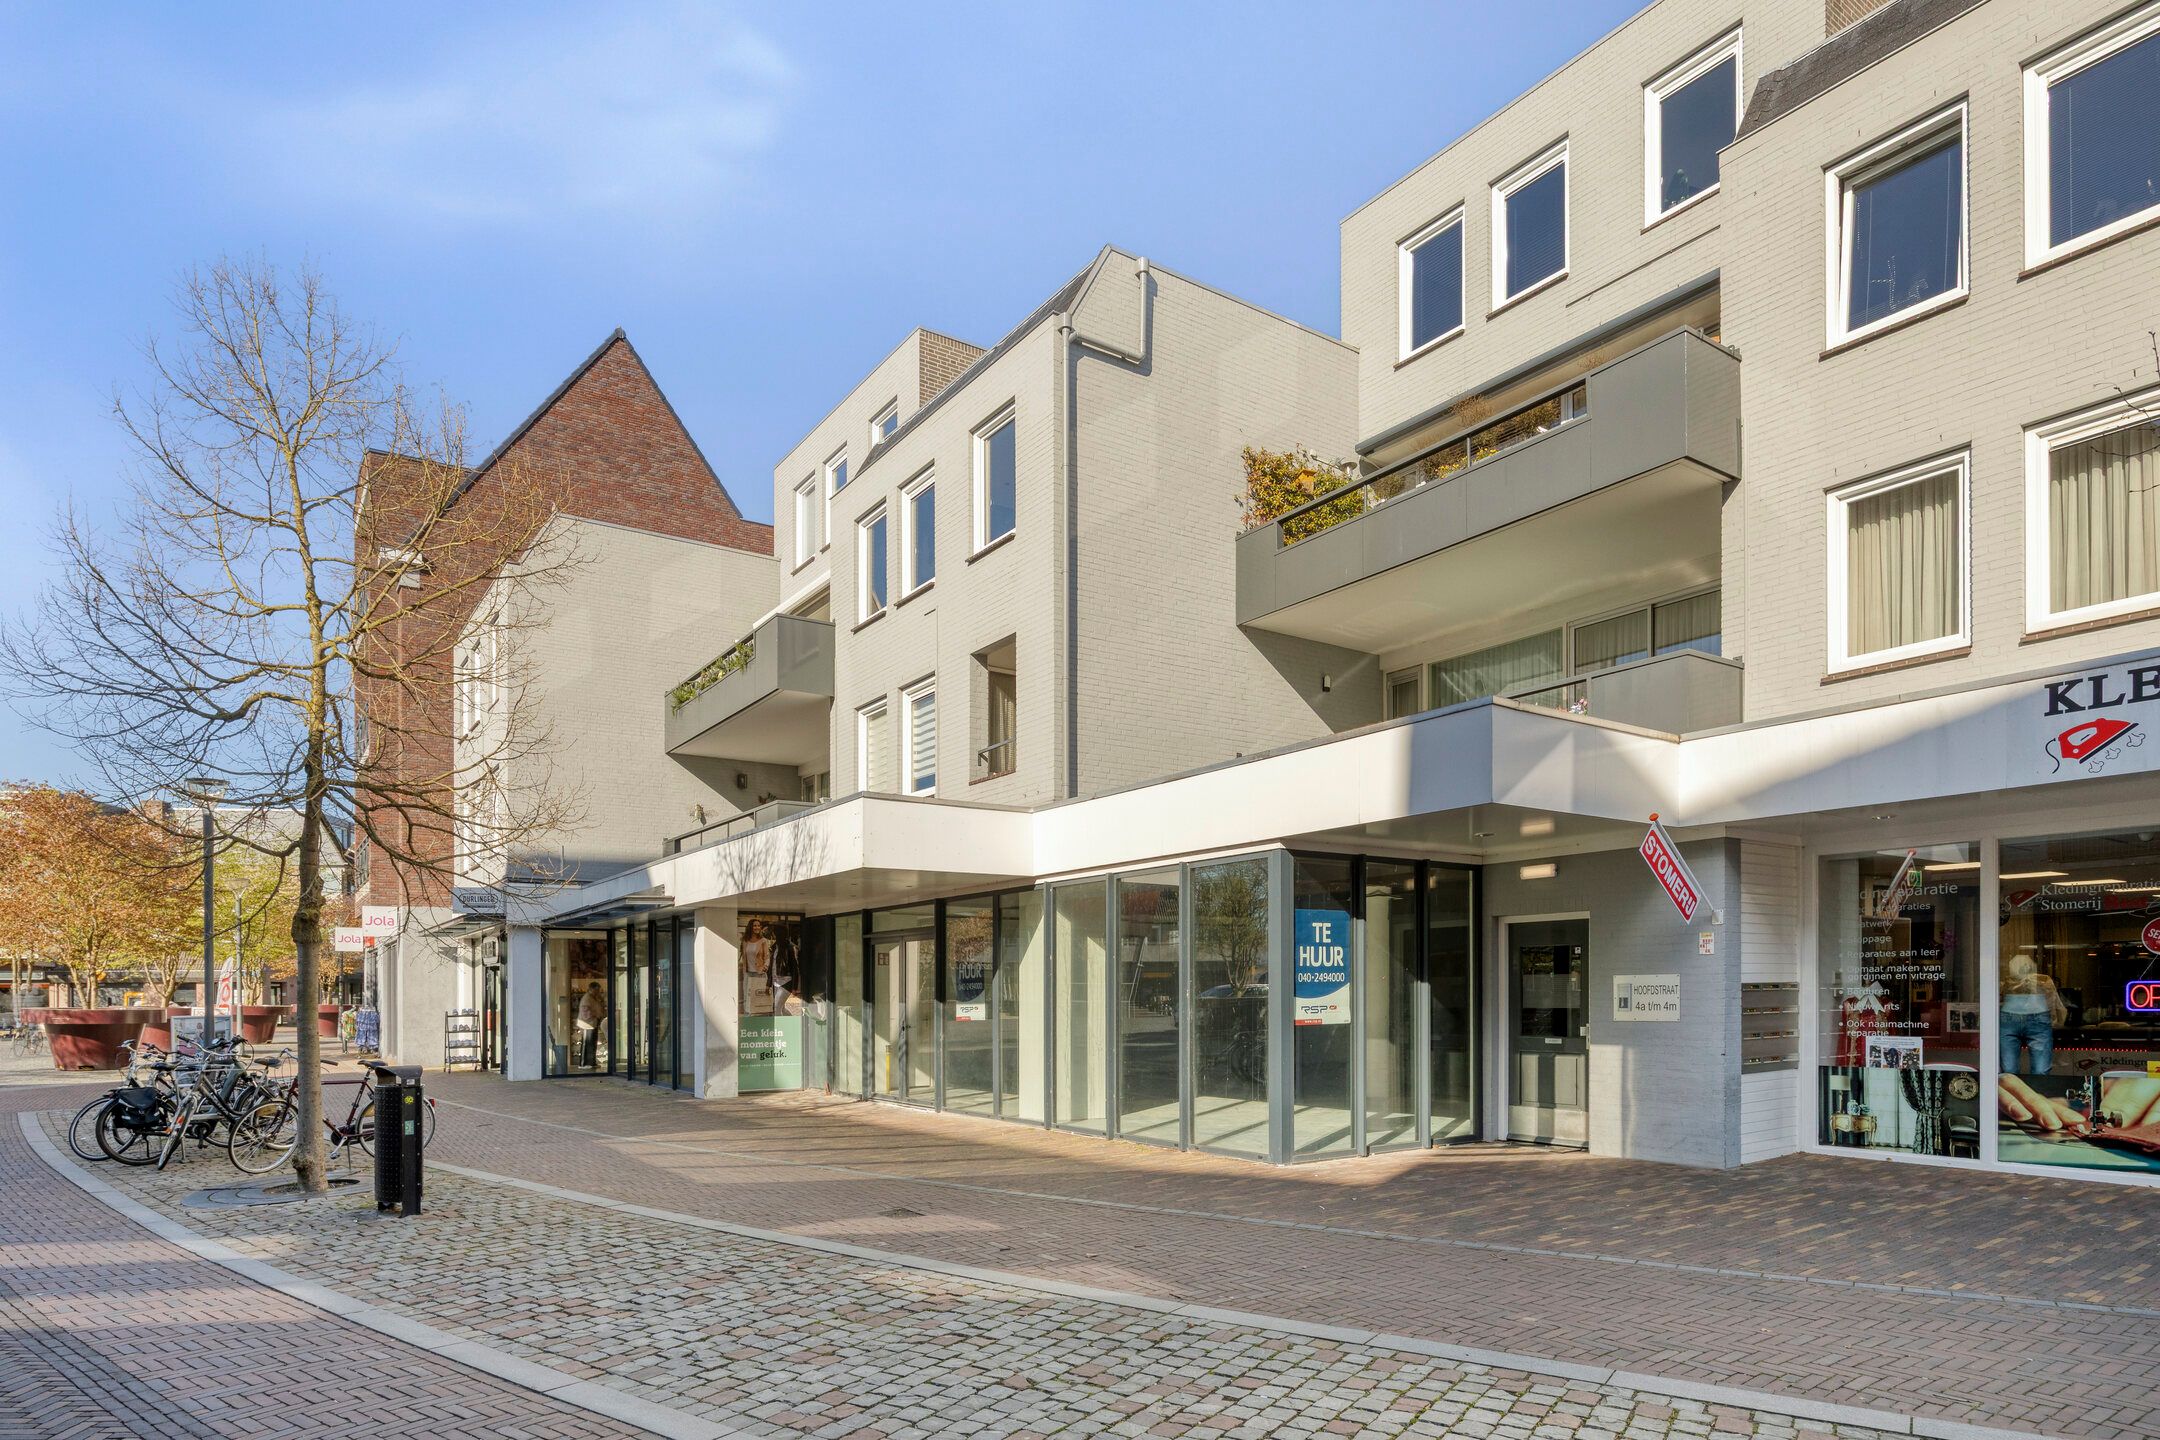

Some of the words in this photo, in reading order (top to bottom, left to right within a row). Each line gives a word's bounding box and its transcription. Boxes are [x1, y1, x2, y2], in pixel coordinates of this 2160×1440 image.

[1645, 835, 1696, 916] STOMERIJ
[2041, 896, 2101, 911] Stomerij
[365, 915, 395, 927] Jola
[1311, 922, 1332, 943] TE
[337, 934, 361, 944] Jola
[1299, 945, 1344, 967] HUUR
[1847, 949, 1897, 960] Reparaties
[1920, 948, 1940, 957] leer
[958, 961, 982, 979] HUUR
[1887, 964, 1920, 973] maken
[1895, 973, 1908, 981] en
[1910, 971, 1946, 981] vitrage
[1633, 984, 1679, 995] HOOFDSTRAAT
[1635, 1001, 1646, 1011] 4a
[1648, 1001, 1661, 1011] t/m
[1663, 1001, 1677, 1011] 4m
[1884, 1002, 1900, 1011] rits
[1846, 1019, 1865, 1028] Ook
[1868, 1020, 1930, 1029] naaimachine
[740, 1029, 758, 1038] Een
[761, 1028, 784, 1037] klein
[740, 1039, 787, 1050] momentje
[760, 1050, 787, 1060] geluk.
